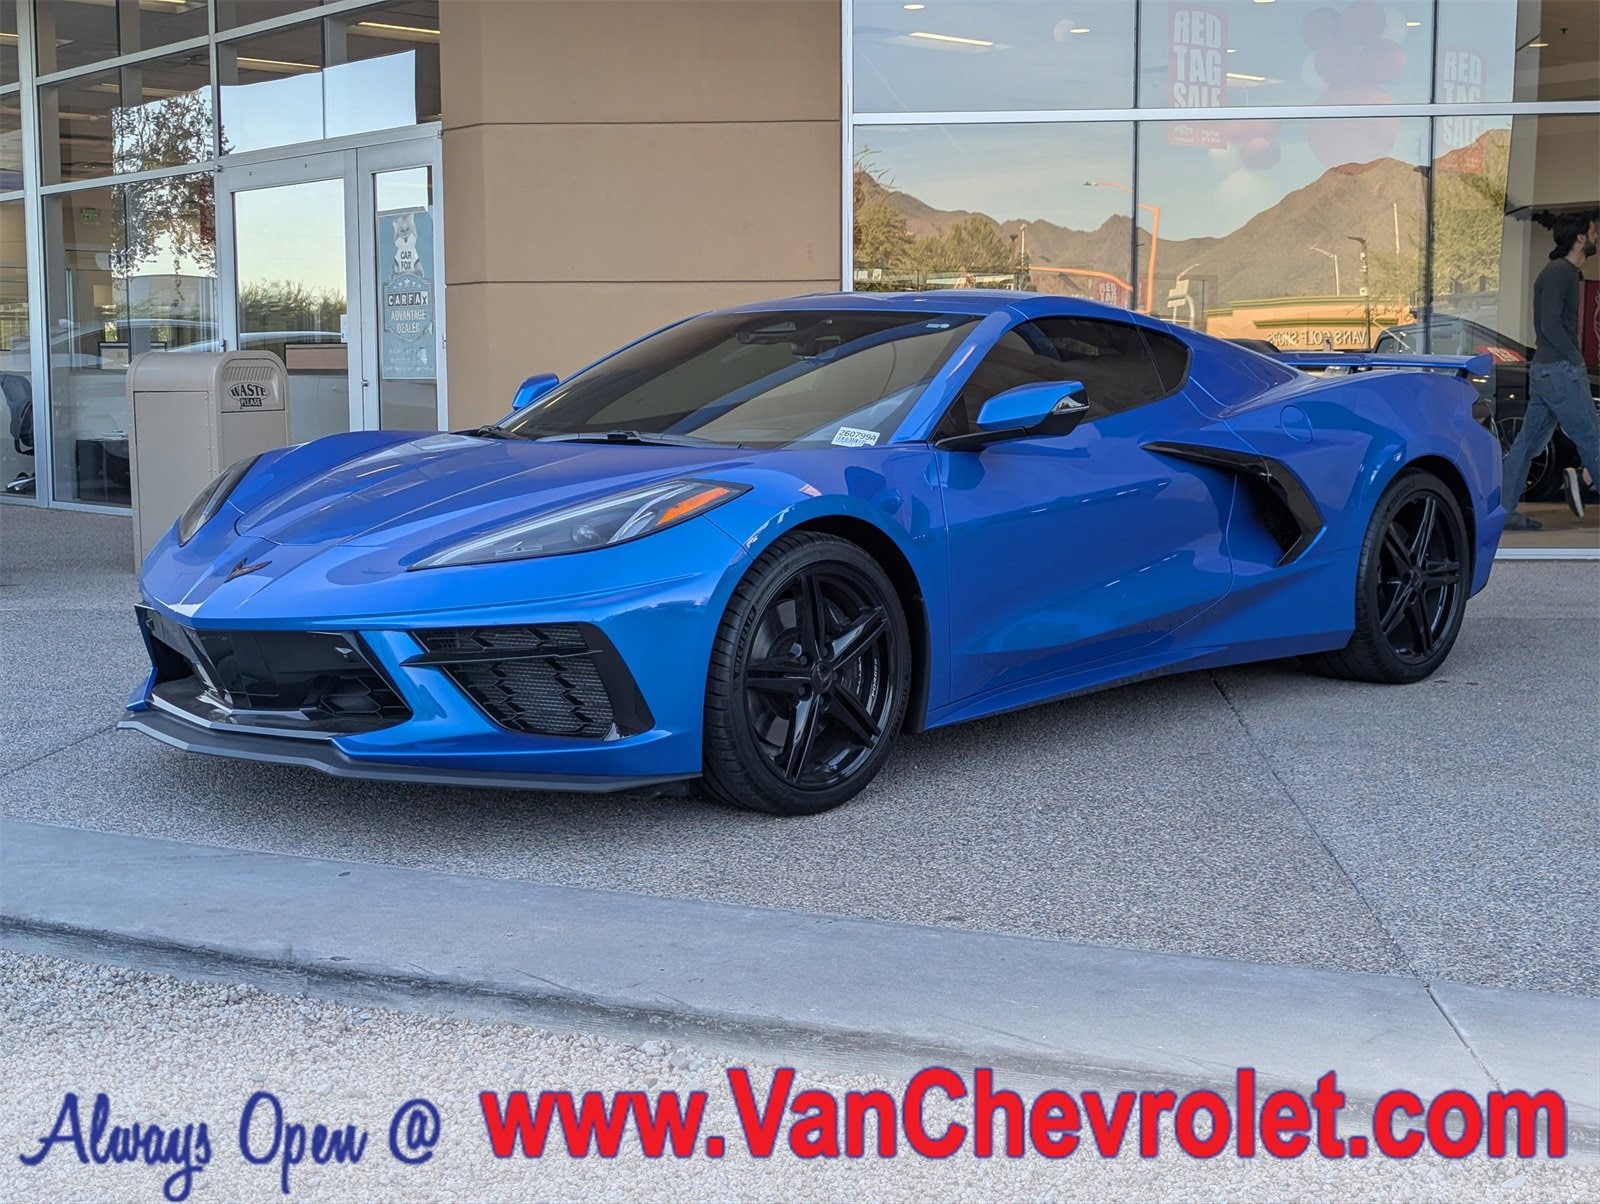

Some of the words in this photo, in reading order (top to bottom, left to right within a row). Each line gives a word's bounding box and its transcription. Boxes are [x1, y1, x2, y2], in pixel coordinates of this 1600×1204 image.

[1174, 10, 1221, 48] RED
[1174, 45, 1221, 86] TAG
[1444, 51, 1482, 84] RED
[1173, 82, 1221, 107] SALE
[1443, 81, 1481, 103] TAG
[400, 250, 412, 260] CAR
[400, 260, 412, 270] FOX
[1100, 282, 1117, 291] RED
[387, 291, 429, 306] CARFAX
[390, 309, 426, 321] ADVANTAGE
[396, 322, 420, 333] DEALER
[230, 383, 268, 396] WASTE
[838, 429, 877, 441] 260799A
